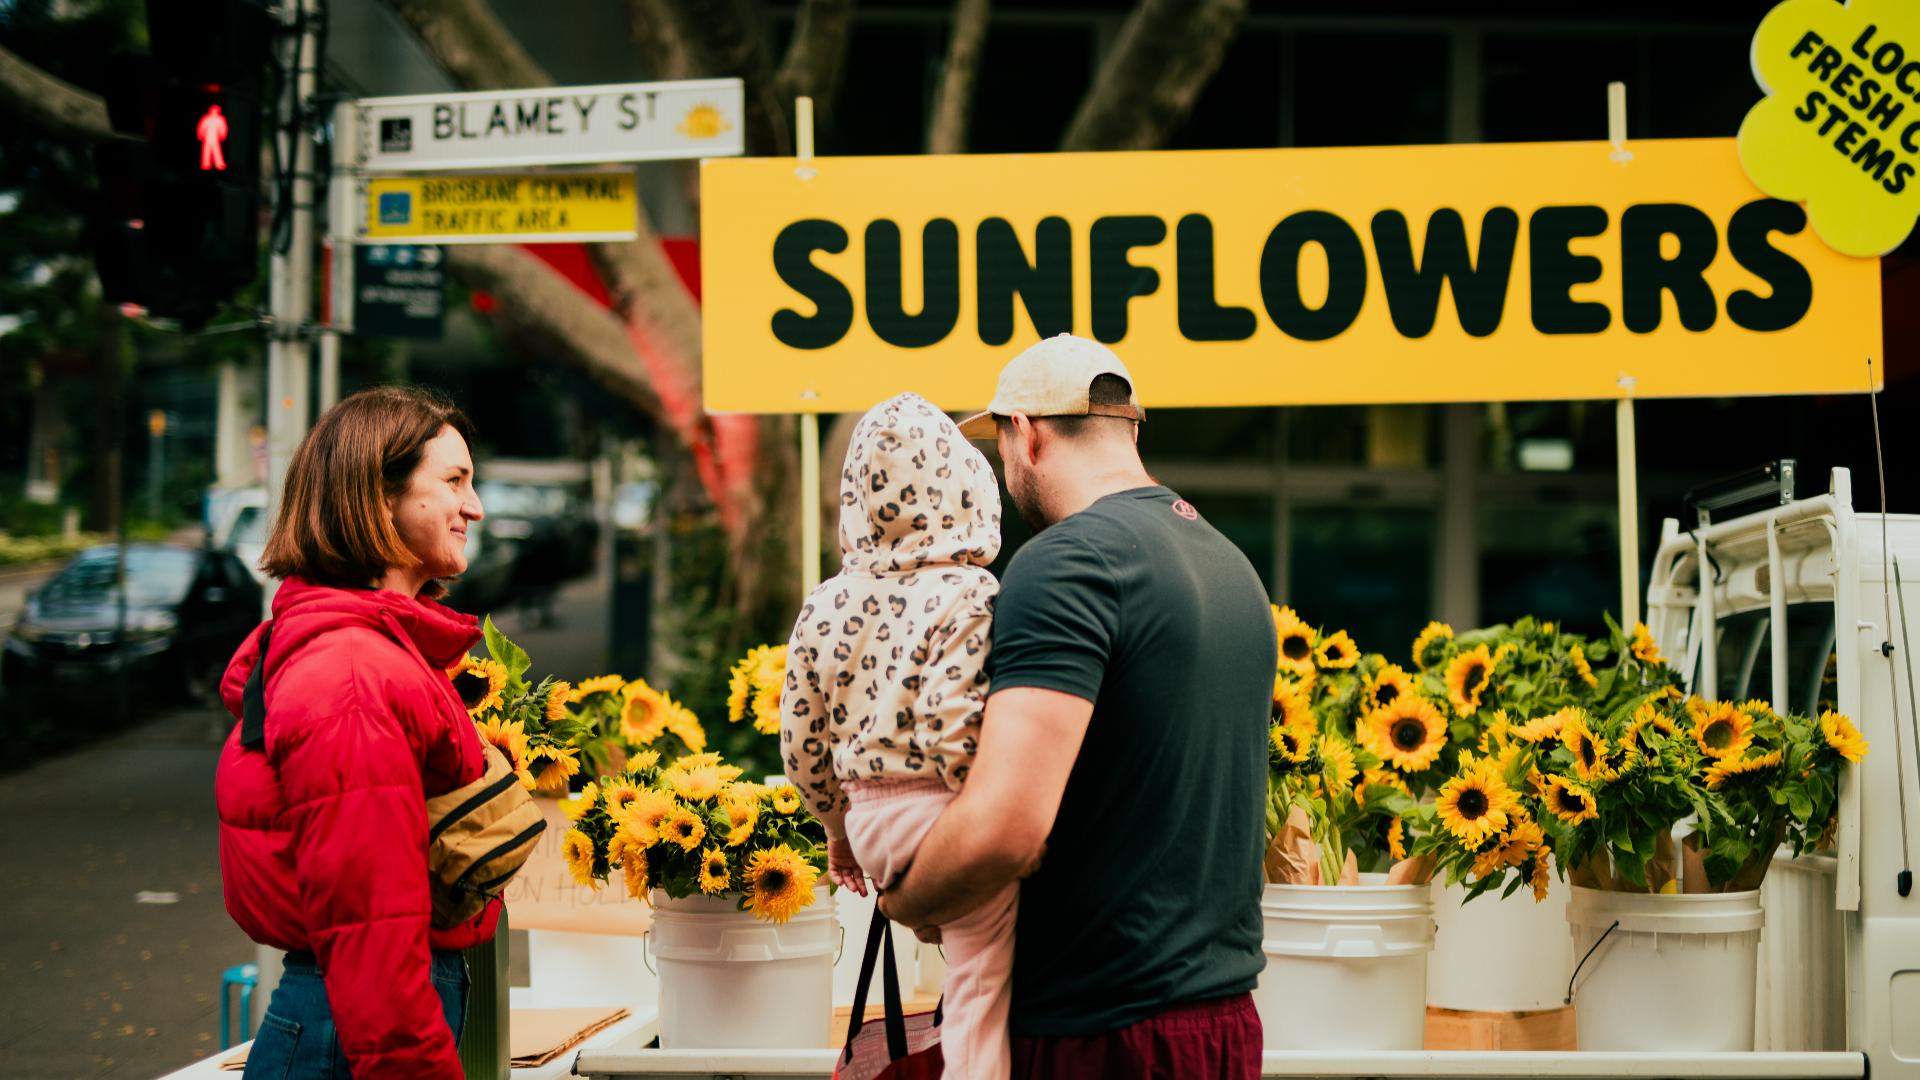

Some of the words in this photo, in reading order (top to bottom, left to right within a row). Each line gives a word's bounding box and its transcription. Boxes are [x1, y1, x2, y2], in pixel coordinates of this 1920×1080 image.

[432, 97, 598, 140] BLAMEY
[617, 92, 660, 131] ST
[1790, 30, 1905, 132] FRESH
[1795, 90, 1916, 195] STEMS
[421, 178, 519, 204] BRISBANE
[529, 174, 624, 202] CENTRAL
[422, 207, 506, 231] TRAFFIC
[515, 206, 569, 229] AREA
[770, 196, 1813, 351] SUNFLOWERS
